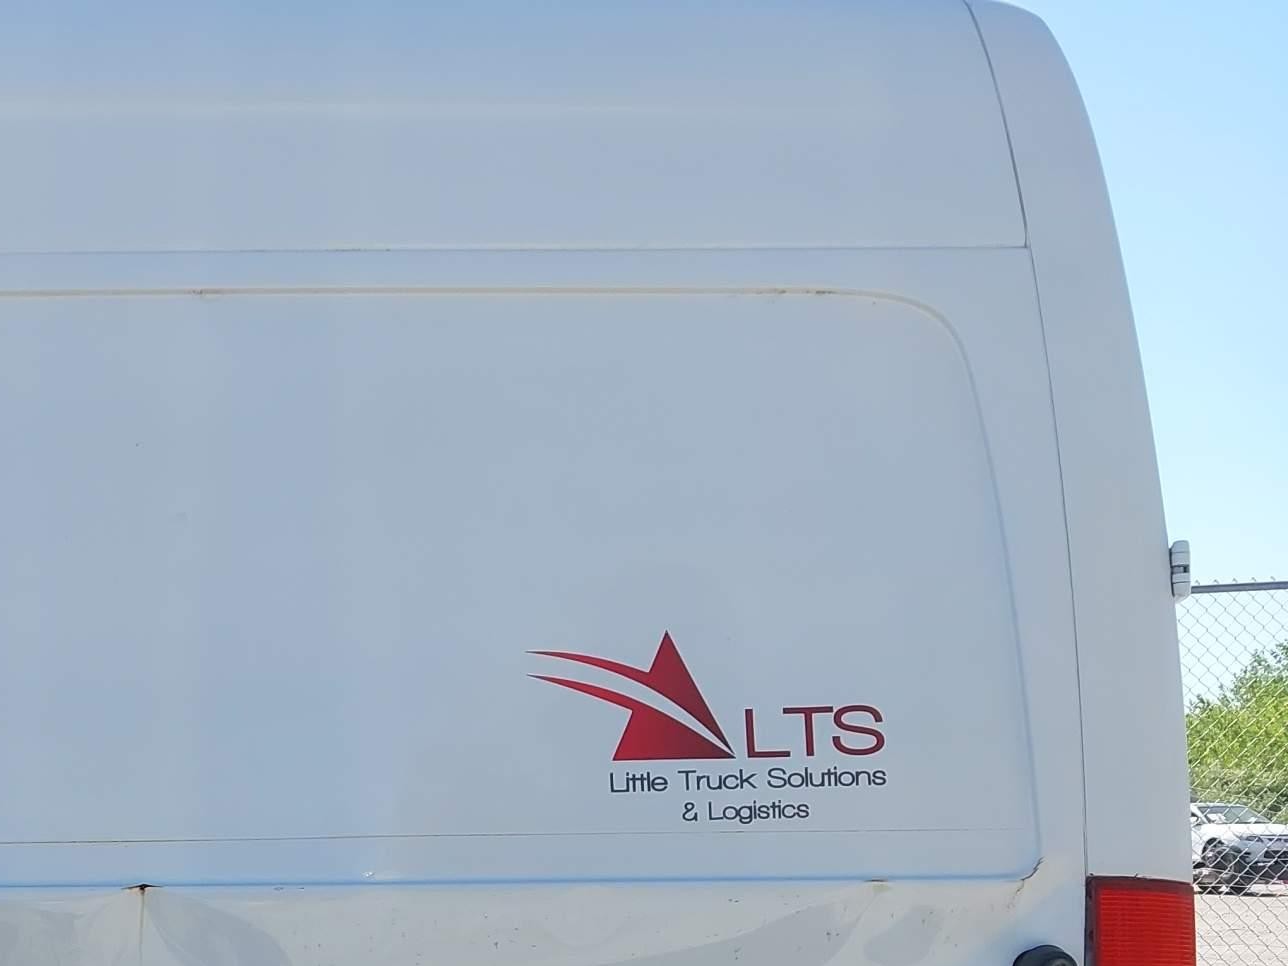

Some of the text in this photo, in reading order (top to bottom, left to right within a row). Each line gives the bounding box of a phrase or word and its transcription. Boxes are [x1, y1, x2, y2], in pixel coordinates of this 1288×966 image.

[744, 704, 886, 758] LTS
[609, 765, 887, 793] Little Truck Solutions
[682, 799, 810, 825] & Logistics
